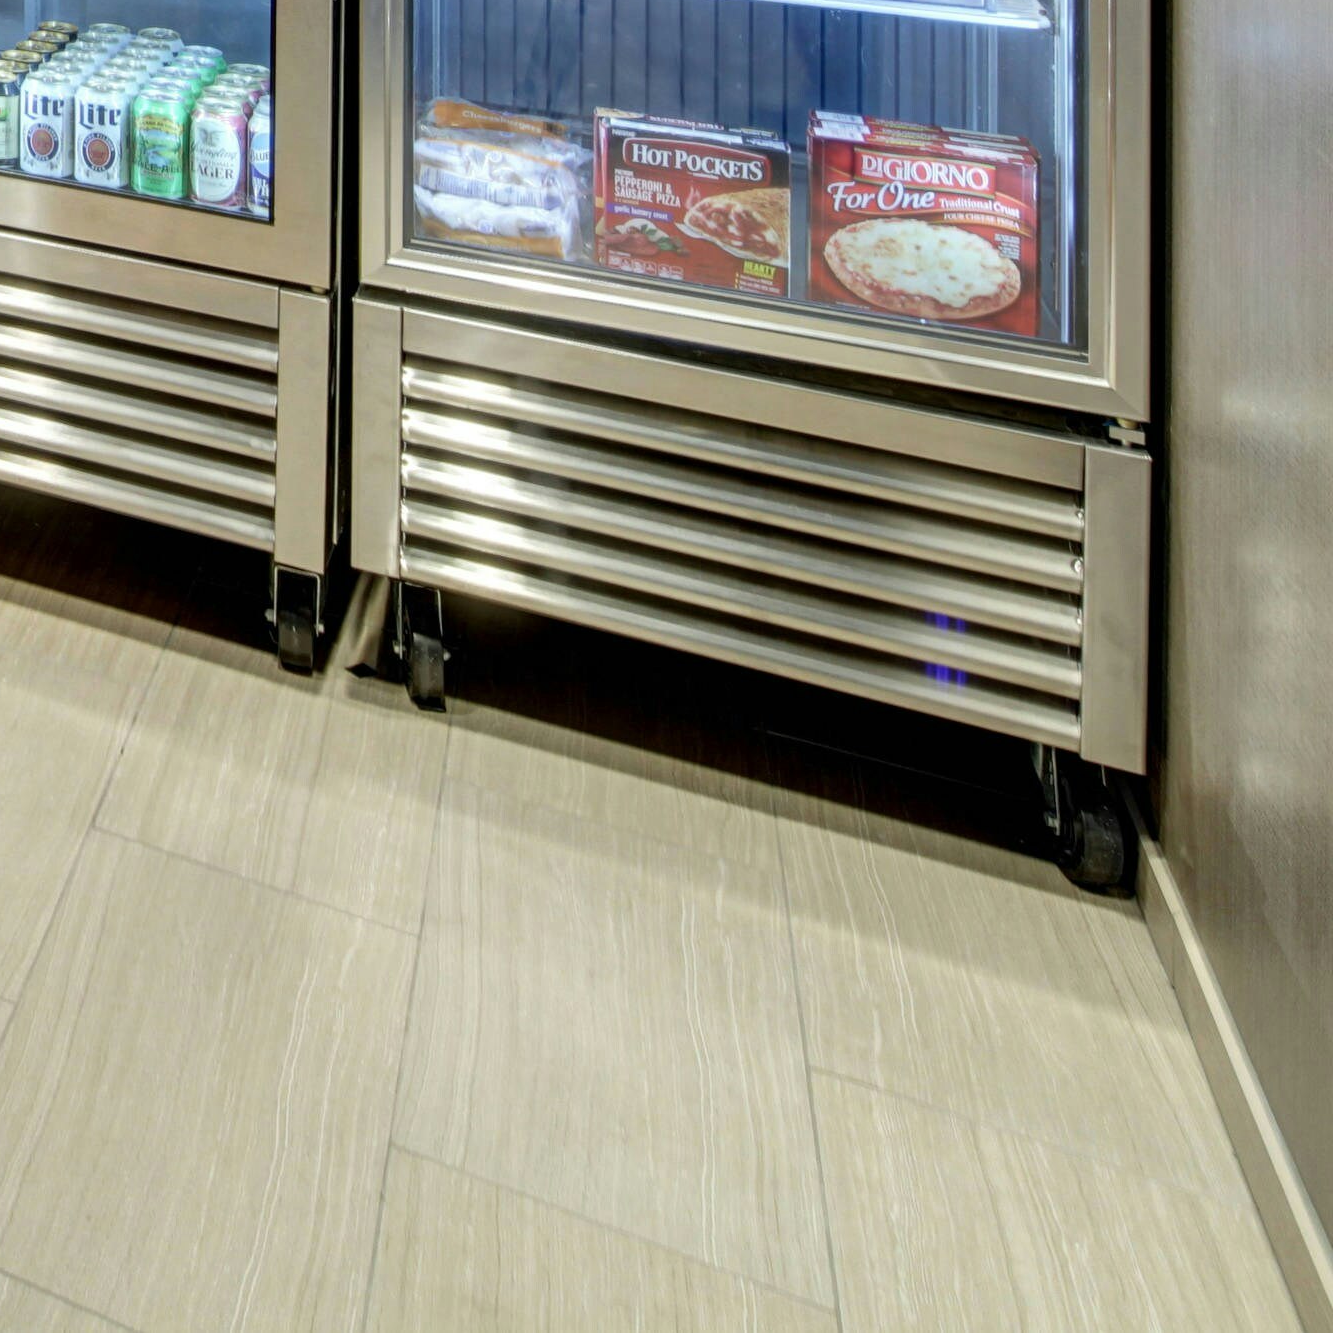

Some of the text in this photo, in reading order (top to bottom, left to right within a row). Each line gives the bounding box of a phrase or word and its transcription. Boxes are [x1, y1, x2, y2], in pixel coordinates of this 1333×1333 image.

[23, 90, 64, 117] Lite
[79, 102, 122, 129] Lite
[631, 143, 764, 183] HOT POCKETS
[614, 176, 672, 194] PEPPERONI &
[614, 186, 681, 208] SAUSAGE PIZZA
[827, 180, 935, 212] For One
[939, 197, 1020, 218] Traditional Crust
[743, 261, 777, 278] HEARTY
